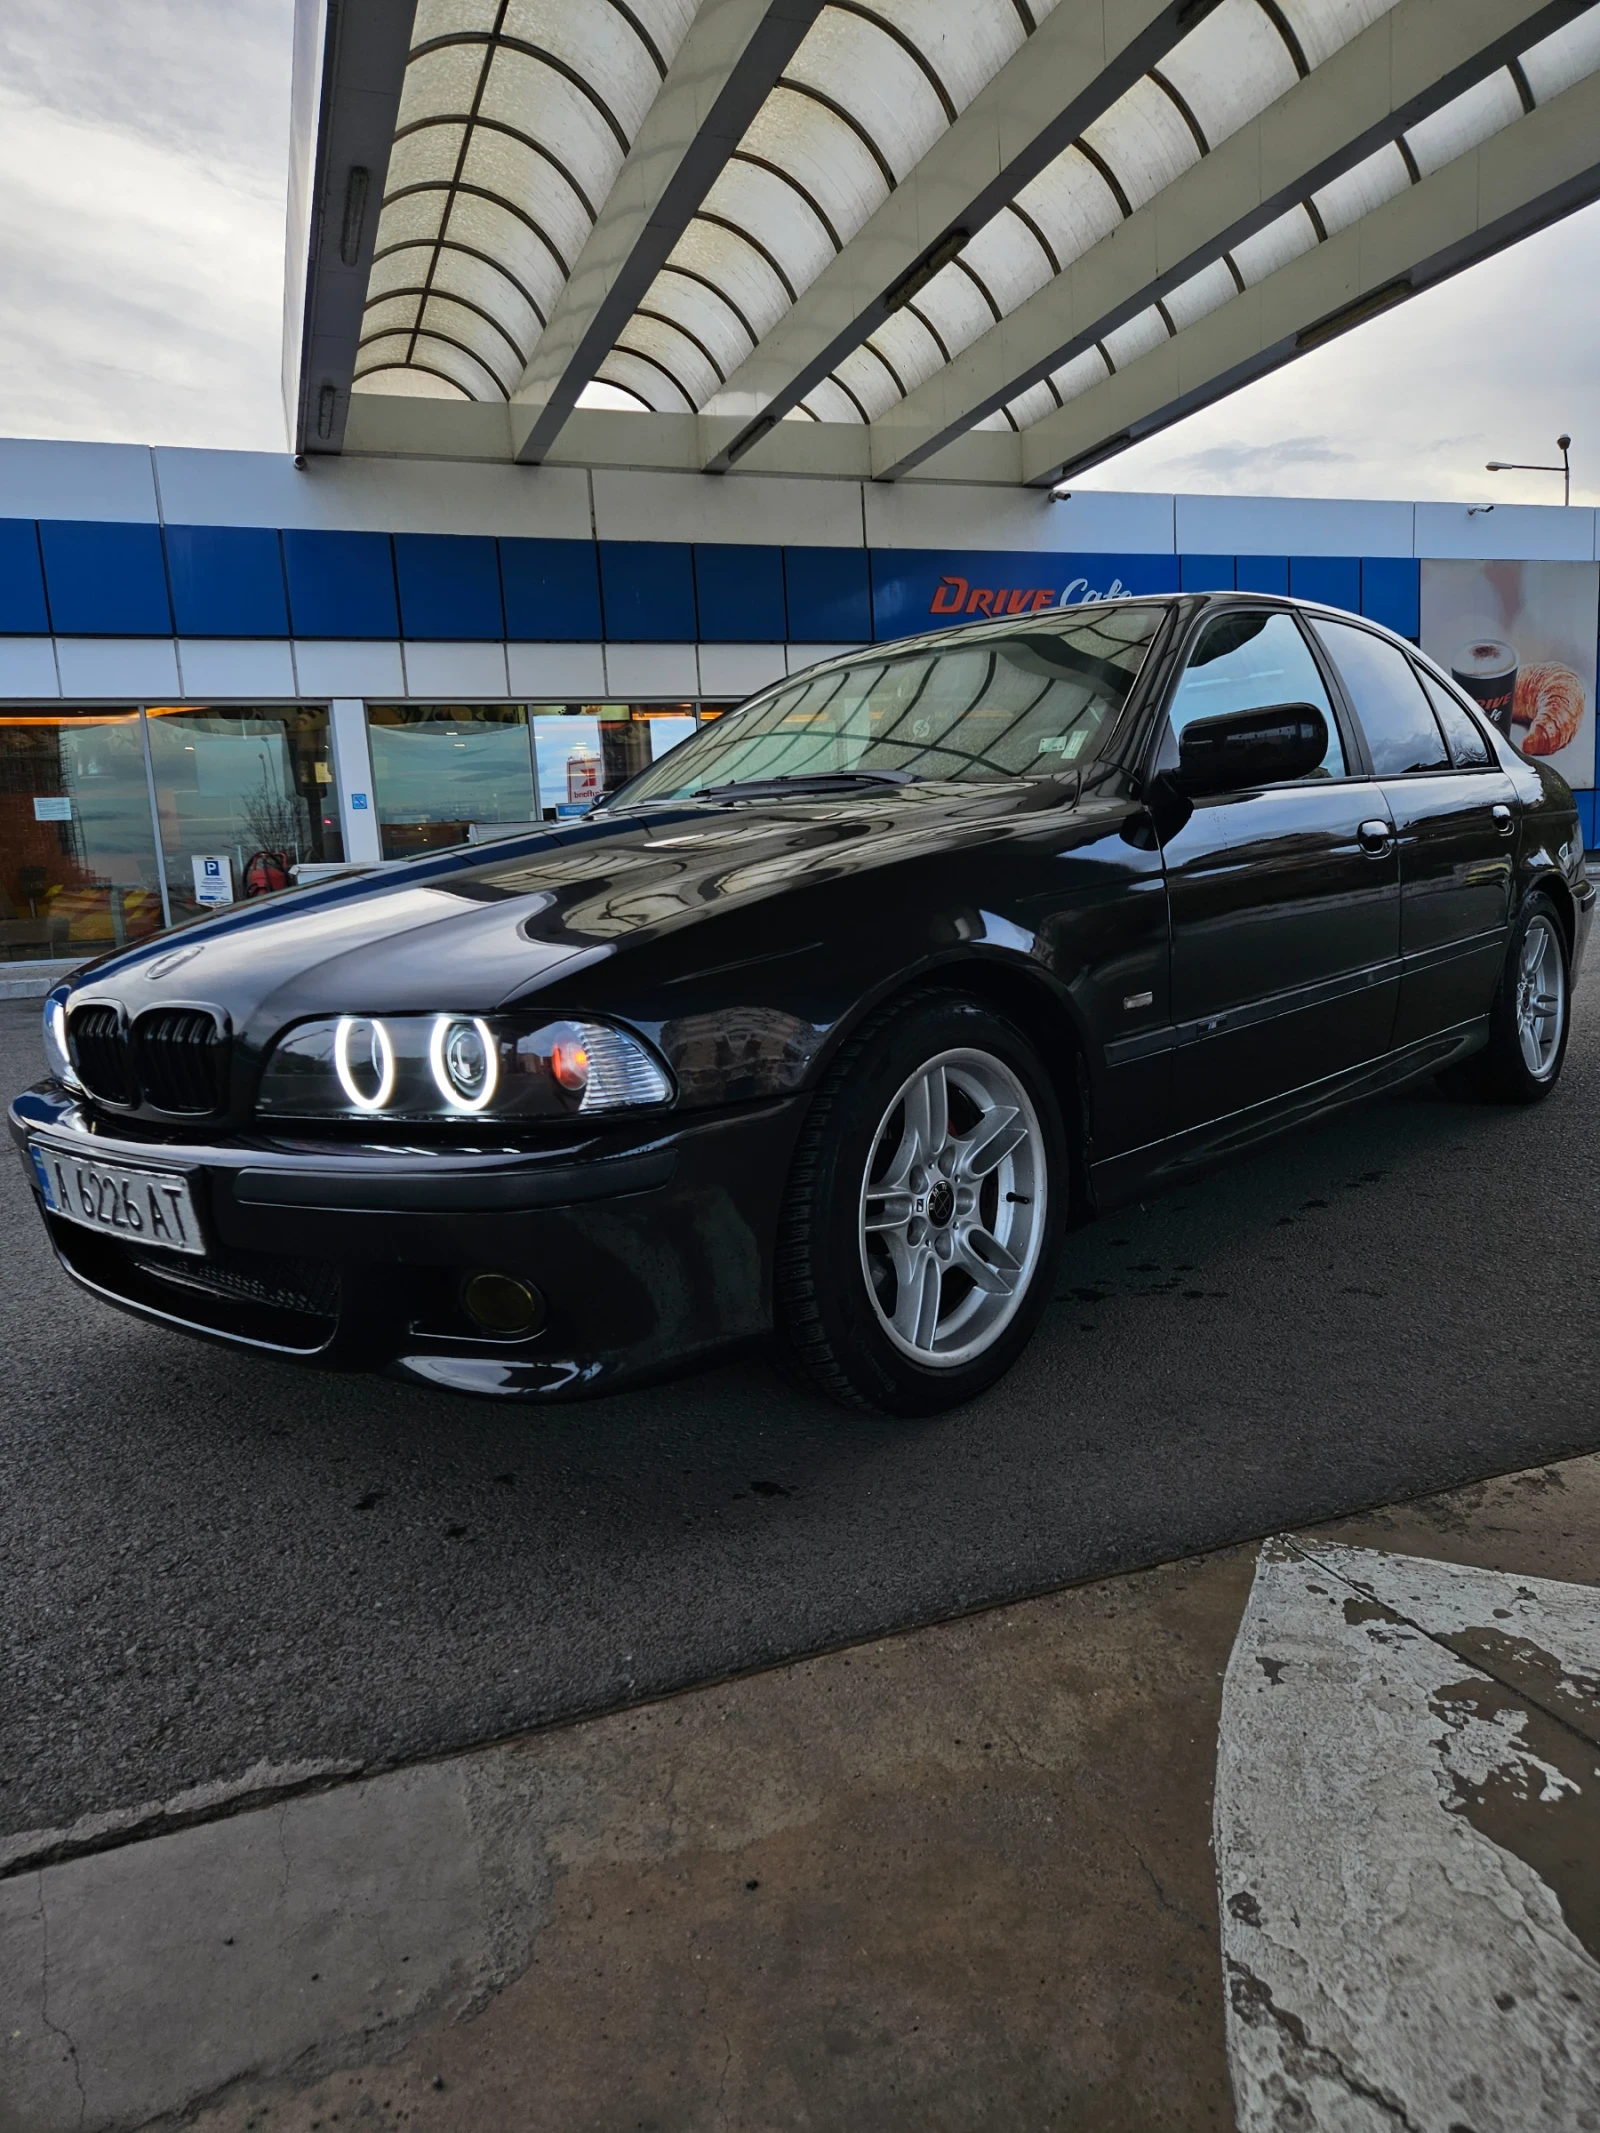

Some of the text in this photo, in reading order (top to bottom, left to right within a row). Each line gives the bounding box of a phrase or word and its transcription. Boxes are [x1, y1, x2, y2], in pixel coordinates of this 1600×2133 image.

[929, 576, 1056, 619] DRIVE
[1475, 692, 1512, 710] RIVE
[53, 1159, 187, 1241] A 6226 AT
